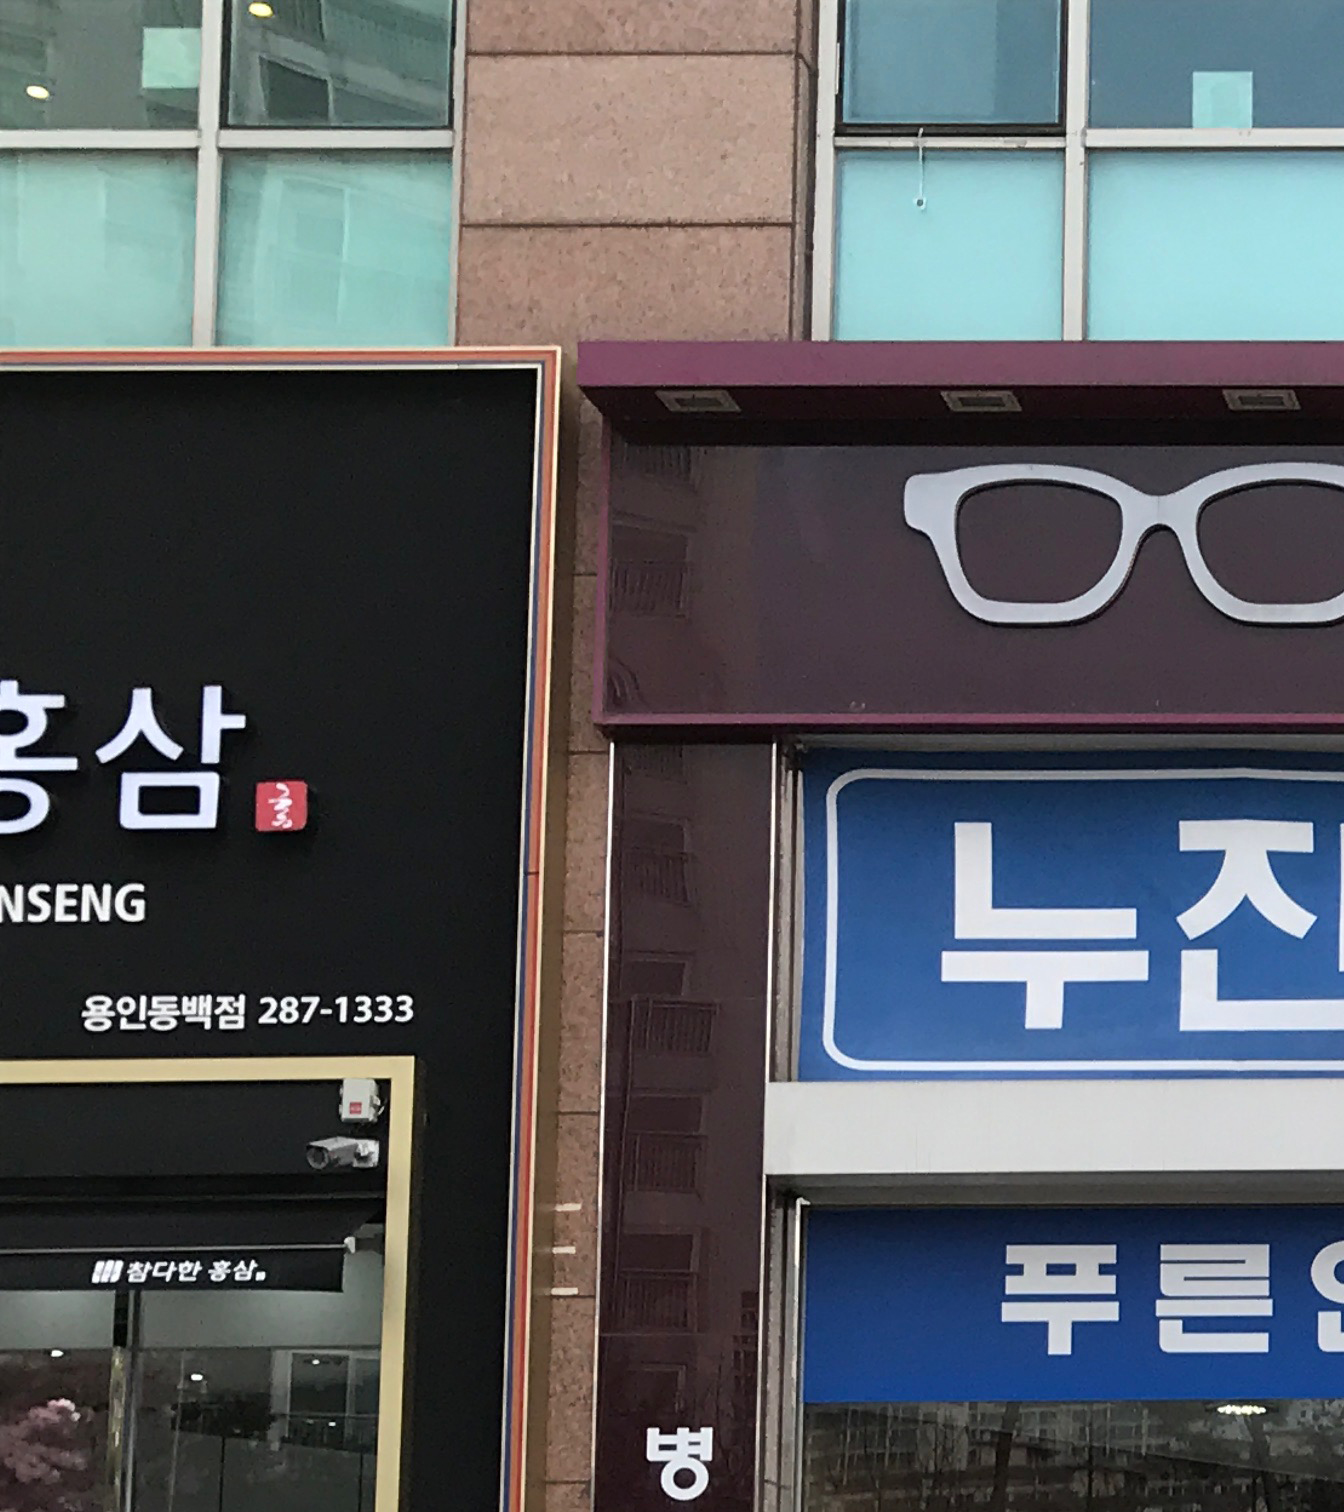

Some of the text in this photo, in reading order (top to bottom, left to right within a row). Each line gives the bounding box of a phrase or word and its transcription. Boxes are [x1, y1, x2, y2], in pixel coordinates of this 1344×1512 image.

[81, 994, 415, 1032] 용인동백점 287-1333
[127, 1261, 202, 1283] 참다한
